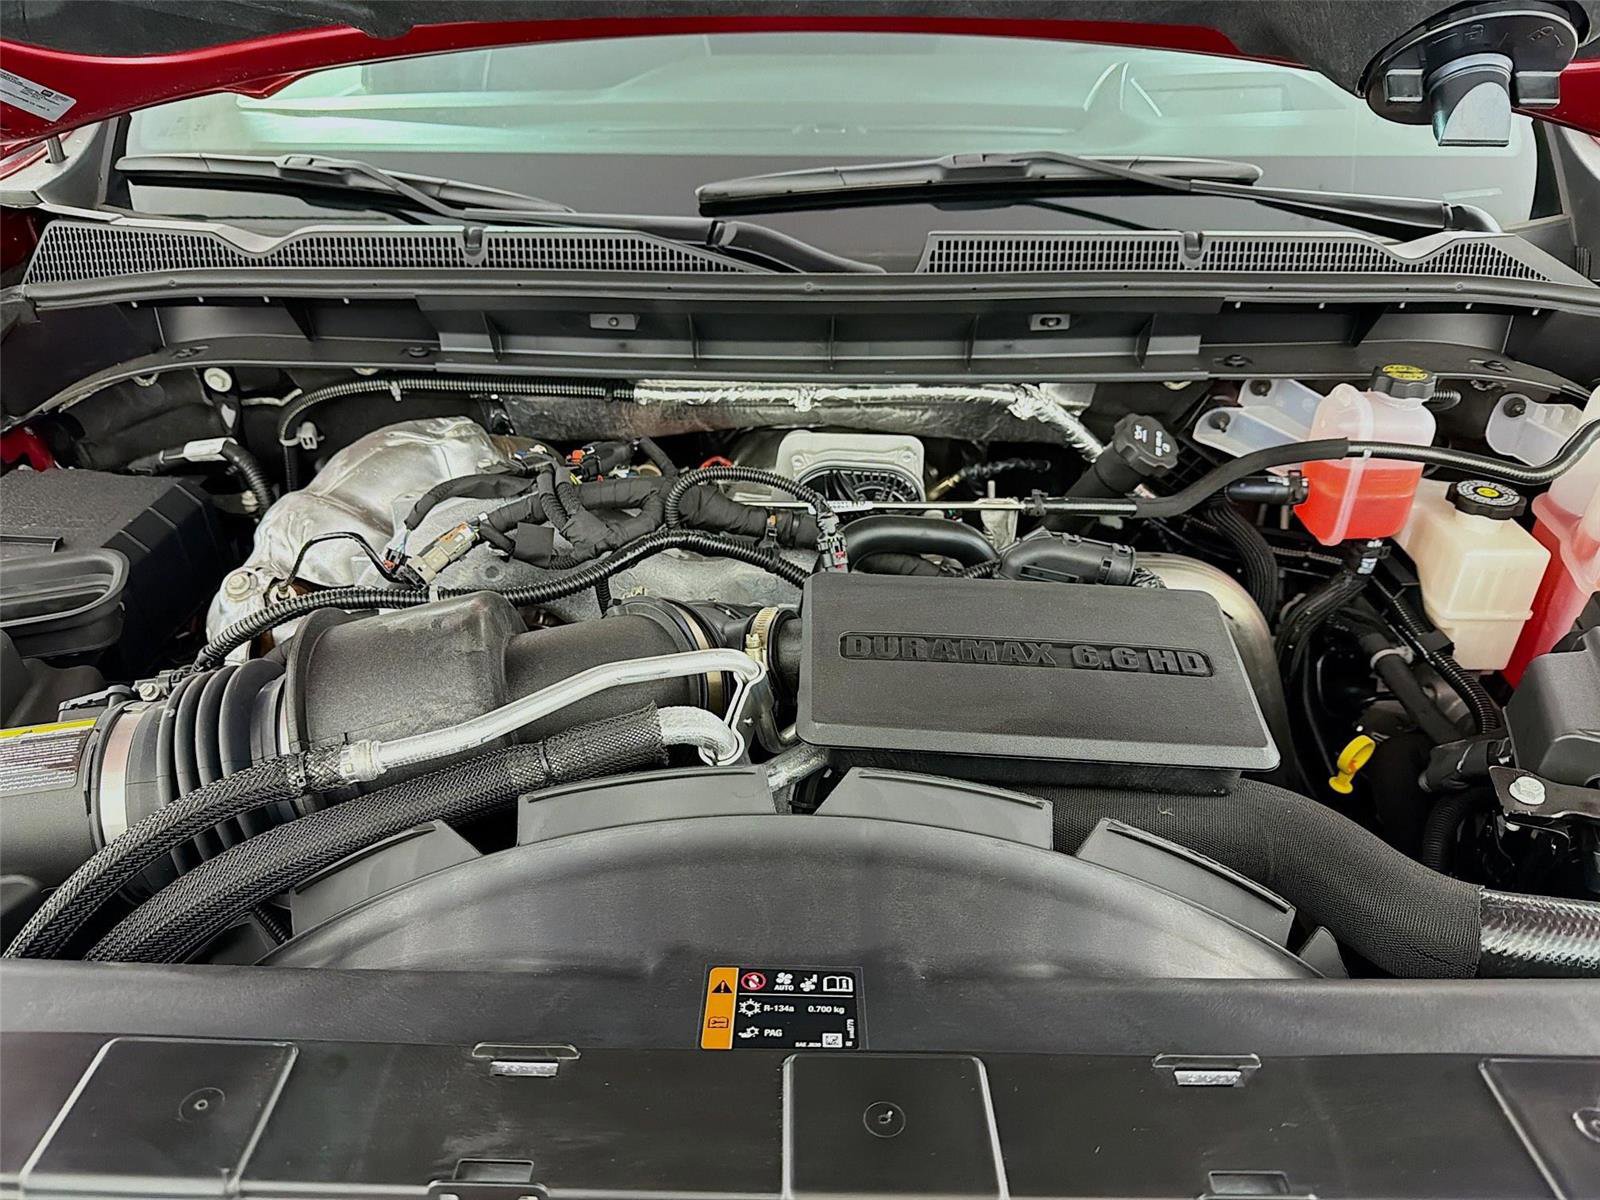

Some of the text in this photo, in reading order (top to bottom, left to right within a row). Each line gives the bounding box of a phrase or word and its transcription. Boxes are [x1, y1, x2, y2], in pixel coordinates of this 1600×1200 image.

[846, 635, 1214, 674] DURAMAX 6.6 HD
[763, 1004, 795, 1012] R-134a
[807, 1005, 845, 1014] 0.700 kg
[764, 1028, 783, 1037] PAG
